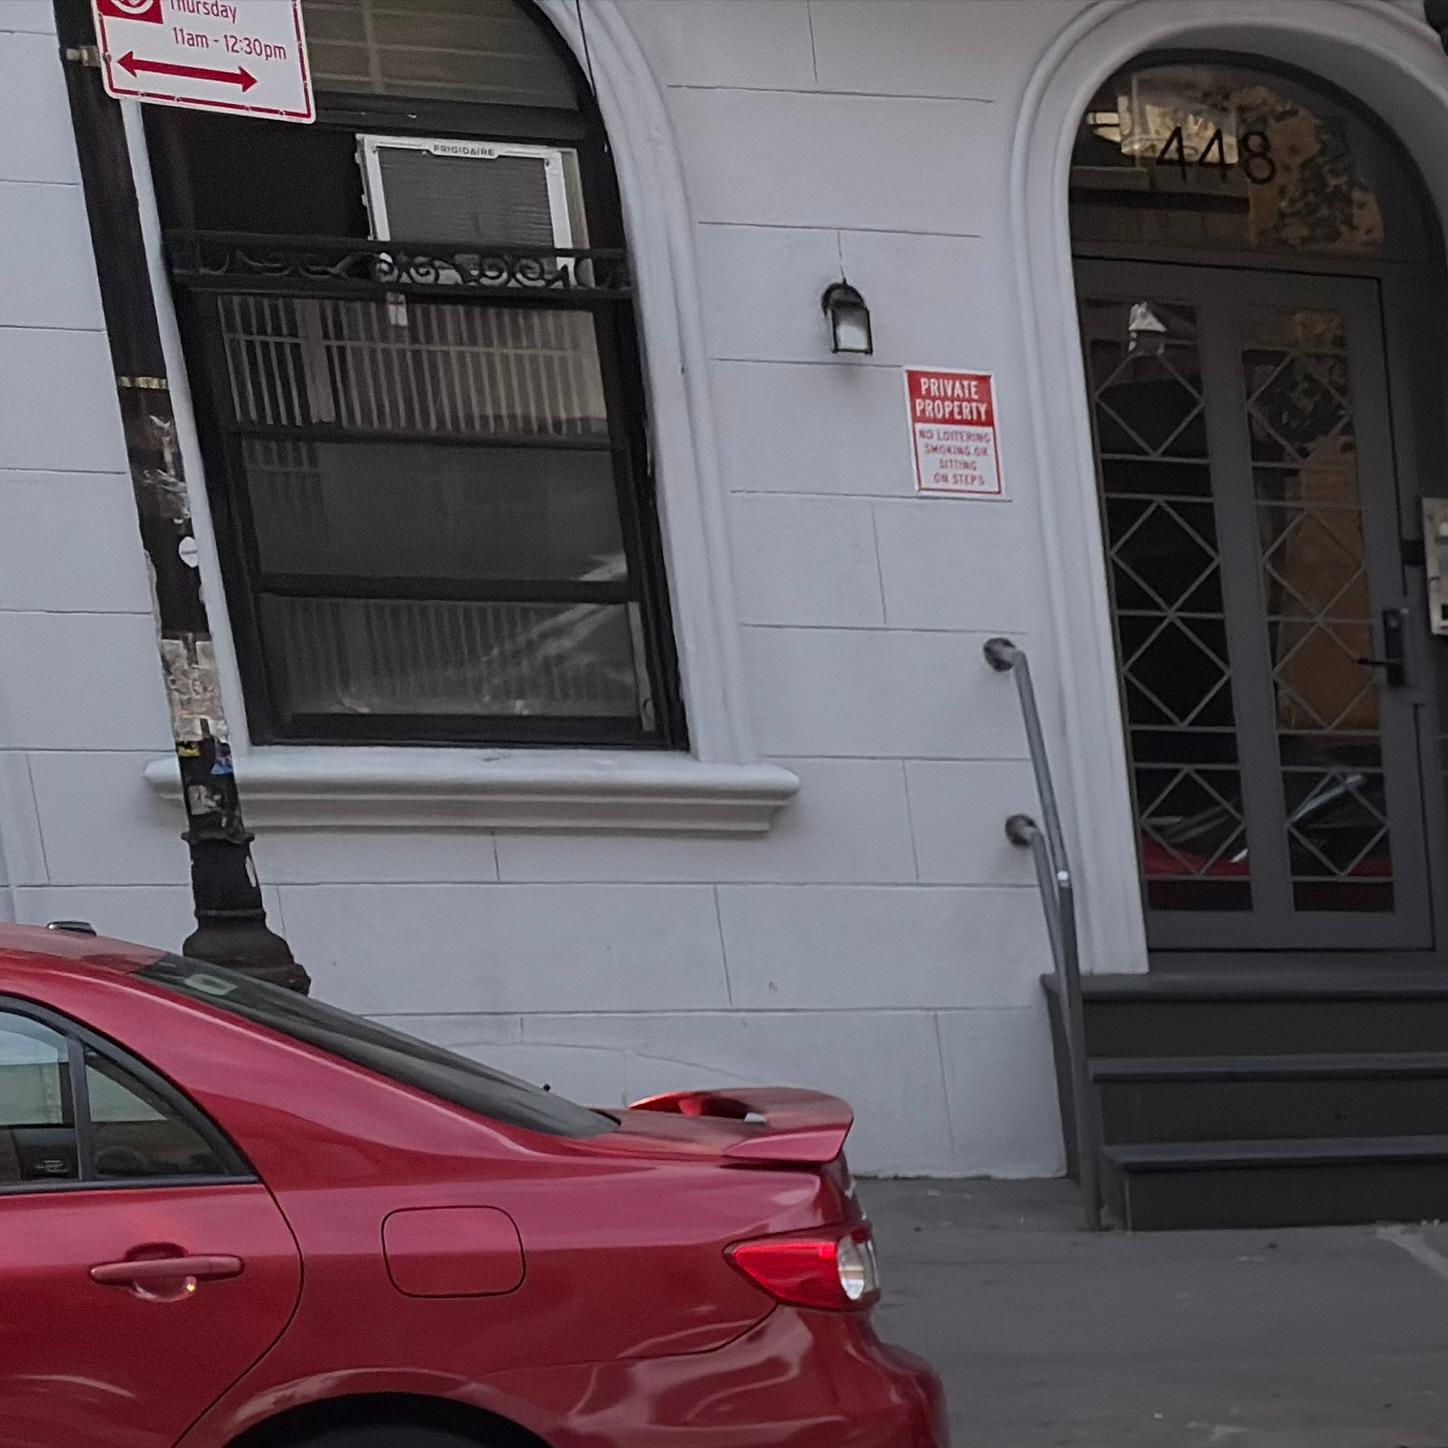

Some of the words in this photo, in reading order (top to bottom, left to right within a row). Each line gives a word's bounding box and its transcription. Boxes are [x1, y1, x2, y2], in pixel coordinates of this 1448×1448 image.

[173, 26, 209, 48] 11am
[223, 34, 287, 60] 12:30pm
[433, 144, 494, 156] FRIGIDAIRE
[1156, 124, 1277, 185] 448
[920, 377, 979, 399] PRIVATE
[915, 398, 988, 422] PROPERTY
[919, 429, 934, 440] NO
[925, 443, 971, 456] SMOKING
[939, 458, 977, 472] SITTING
[933, 472, 949, 483] ON
[952, 473, 985, 486] STEPS
